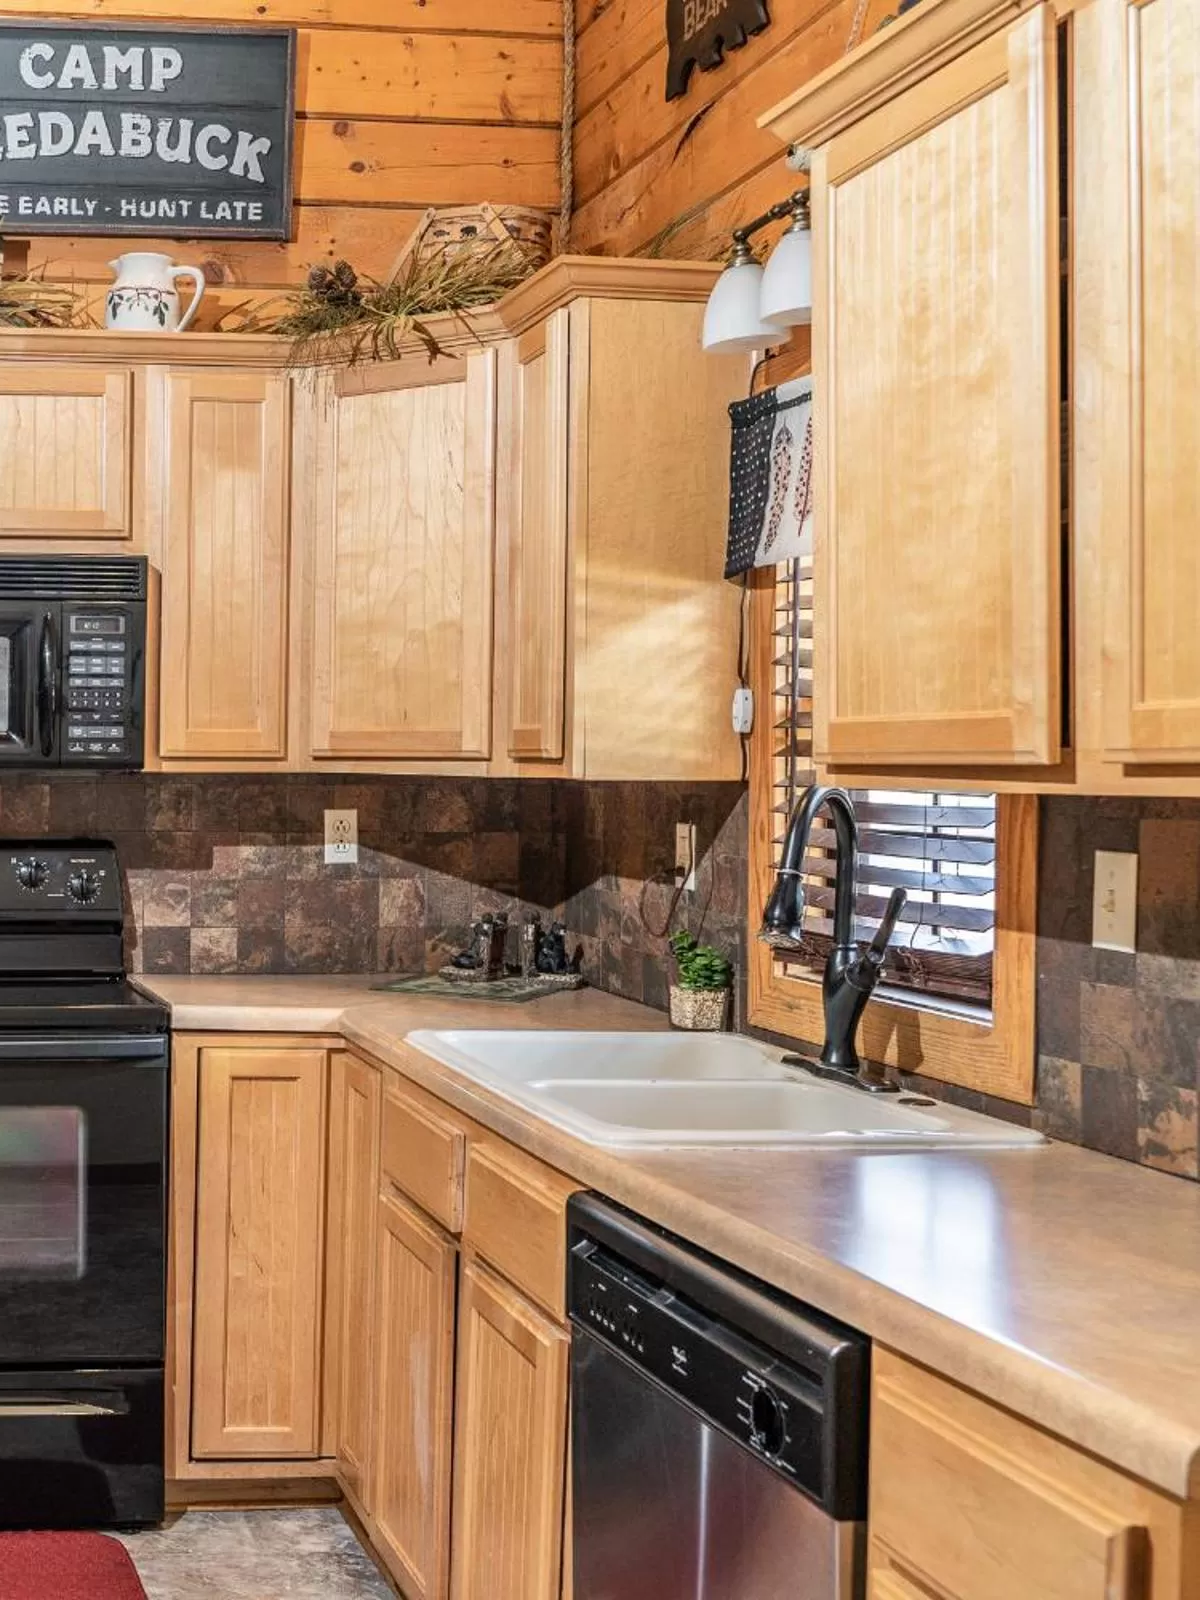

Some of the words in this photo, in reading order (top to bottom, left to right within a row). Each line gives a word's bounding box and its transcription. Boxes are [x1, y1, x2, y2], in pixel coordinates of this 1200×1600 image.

[19, 42, 183, 92] CAMP
[18, 196, 98, 216] EARLY
[120, 199, 192, 217] HUNT
[200, 200, 263, 220] LATE
